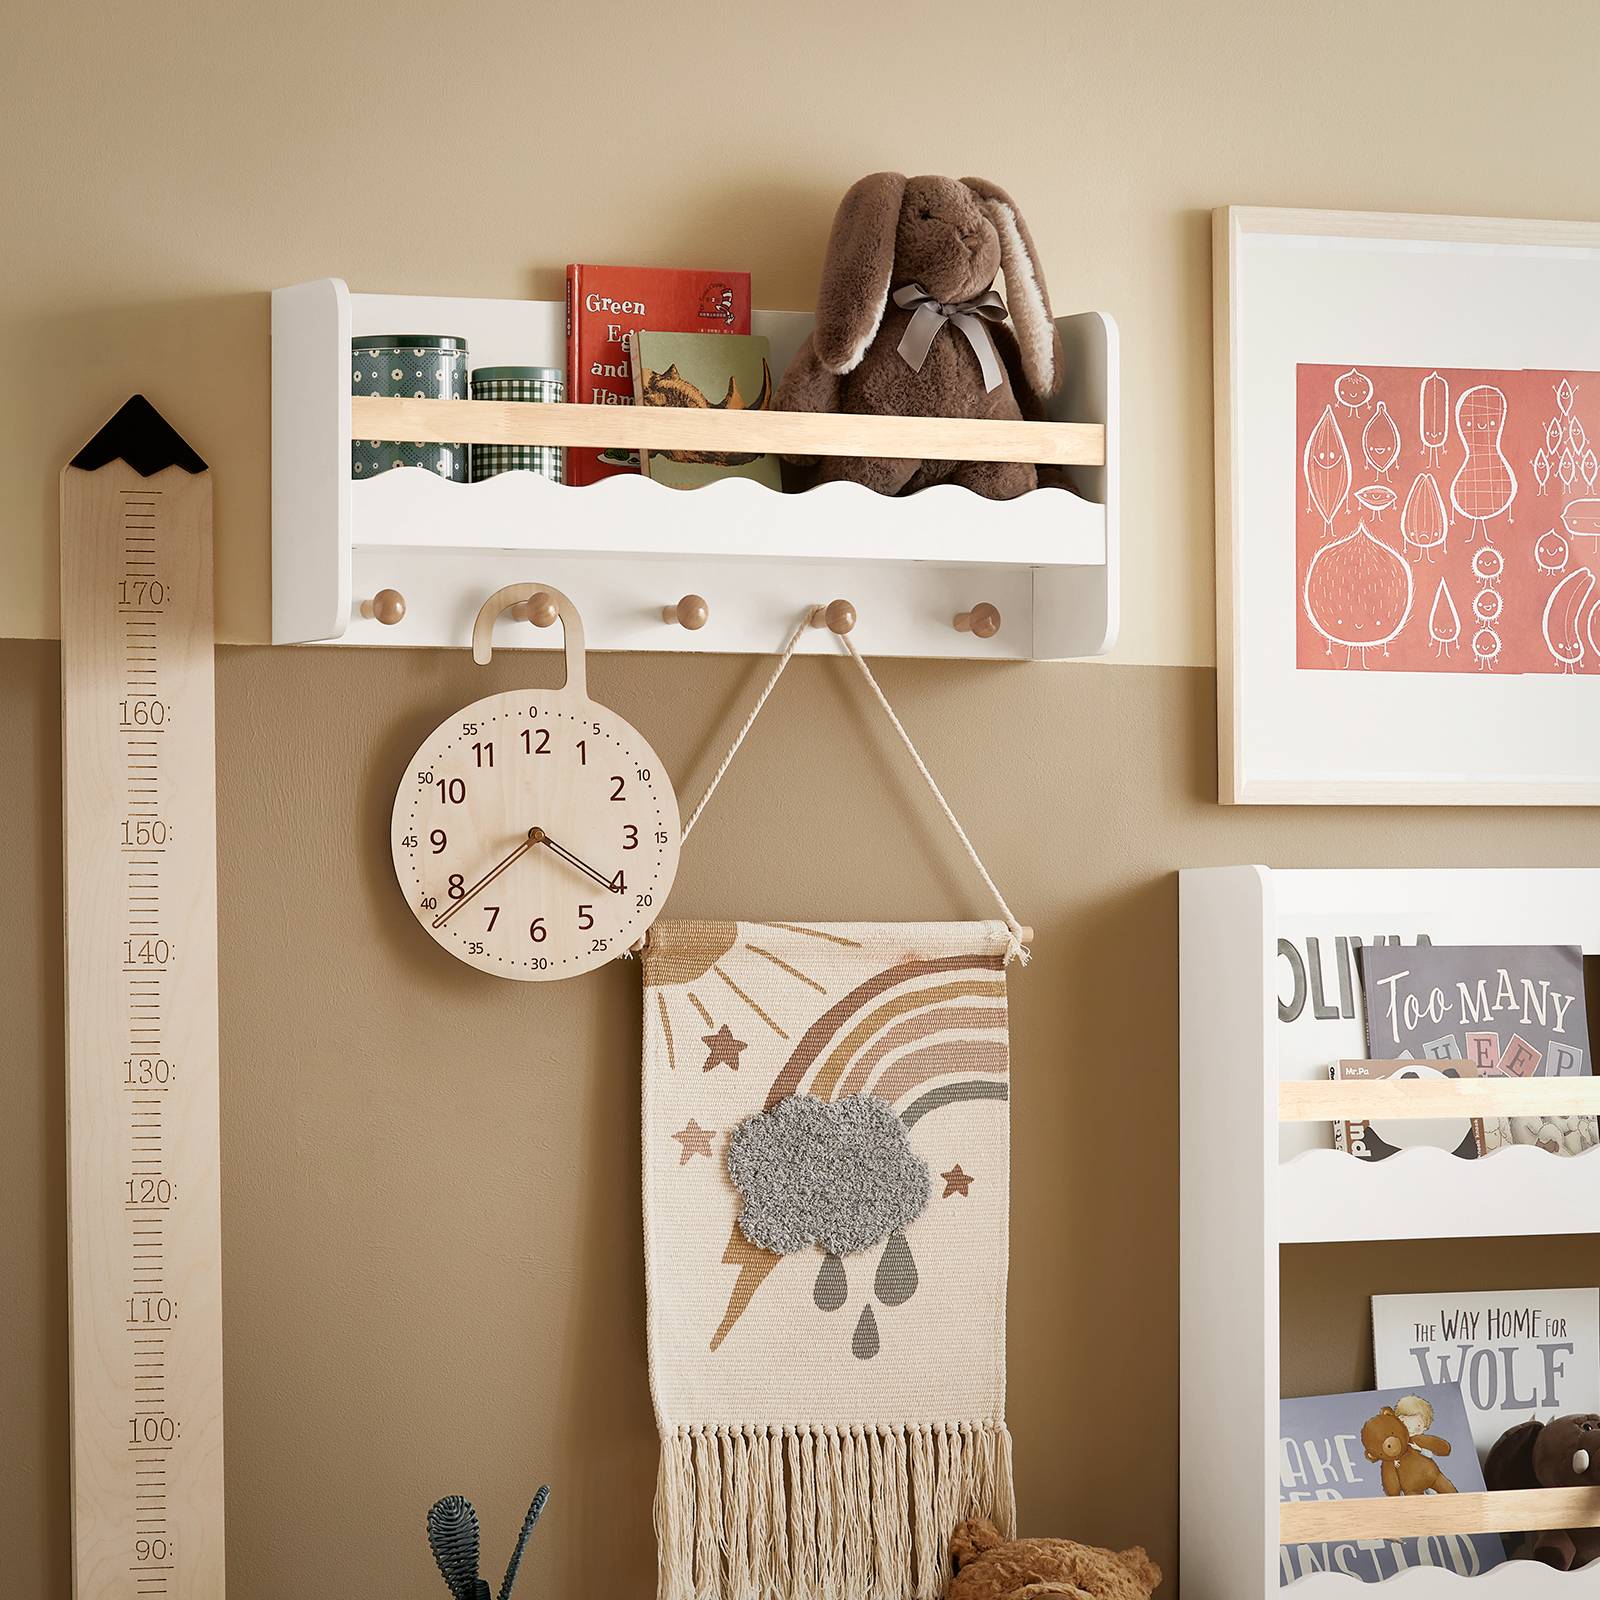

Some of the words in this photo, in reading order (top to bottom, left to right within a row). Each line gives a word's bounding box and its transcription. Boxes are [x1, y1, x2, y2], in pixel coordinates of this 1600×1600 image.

[585, 293, 646, 316] Green
[607, 324, 646, 352] Eg
[591, 360, 629, 378] and
[528, 706, 538, 718] 0
[462, 723, 478, 736] 55
[592, 723, 601, 735] 5
[472, 742, 494, 767] 11
[520, 729, 551, 755] 12
[576, 740, 587, 765] 1
[417, 771, 433, 784] 50
[636, 769, 651, 782] 10
[436, 778, 466, 804] 10
[609, 776, 626, 801] 2
[401, 836, 418, 848] 45
[430, 829, 447, 854] 9
[622, 825, 639, 850] 3
[655, 832, 668, 844] 15
[447, 873, 466, 900] 8
[609, 870, 628, 895] 4
[420, 897, 437, 910] 40
[636, 894, 653, 907] 20
[483, 907, 500, 932] 7
[578, 905, 594, 930] 5
[529, 918, 547, 943] 6
[468, 942, 484, 955] 35
[592, 939, 608, 952] 25
[531, 957, 548, 971] 30
[1277, 934, 1432, 1023] OLI
[1376, 970, 1453, 1043] Too
[1455, 968, 1576, 1033] MANY
[1431, 1038, 1574, 1077] HEEP
[1414, 1323, 1437, 1342] THE
[1440, 1309, 1480, 1341] WAY
[1487, 1308, 1542, 1340] HOME
[1545, 1318, 1567, 1338] FOR
[1409, 1342, 1574, 1410] WOLF
[1280, 1434, 1364, 1488] AKE
